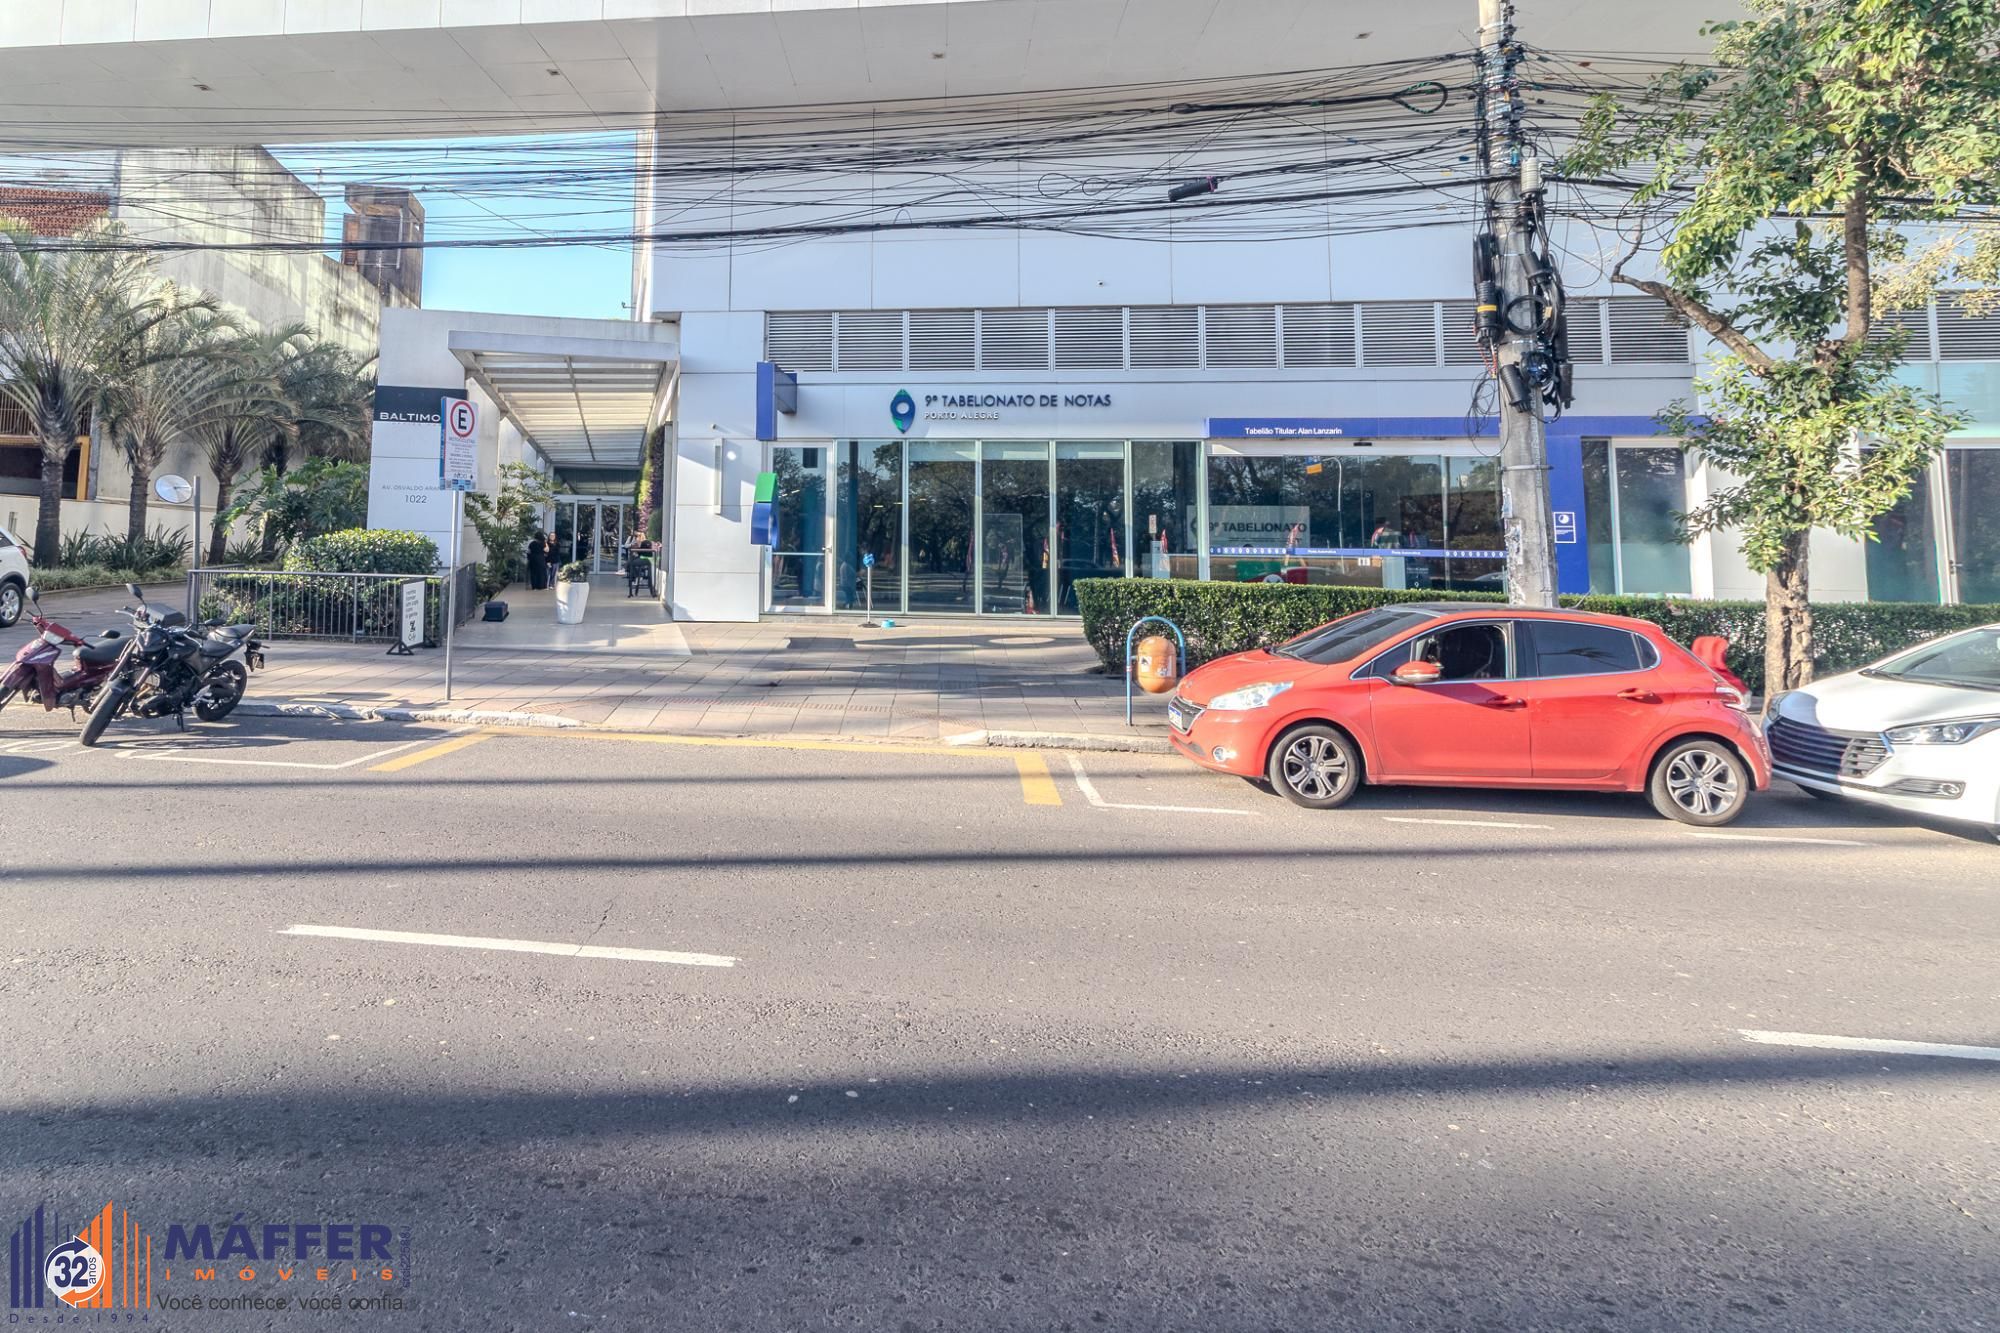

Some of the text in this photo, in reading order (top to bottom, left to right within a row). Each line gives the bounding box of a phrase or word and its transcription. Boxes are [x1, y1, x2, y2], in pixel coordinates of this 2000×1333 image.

[941, 394, 1035, 407] TABELIONATO
[1039, 394, 1058, 407] DE
[1064, 394, 1112, 407] NOTAS
[379, 411, 441, 422] BALTIMO
[458, 408, 468, 430] E
[924, 411, 999, 420] PORTO ALEGRE
[1245, 426, 1274, 435] Tabelião
[1298, 427, 1313, 435] Alan
[1313, 427, 1342, 435] Lanzarin
[405, 494, 427, 504] 1022
[1222, 522, 1308, 533] TABELIONATO
